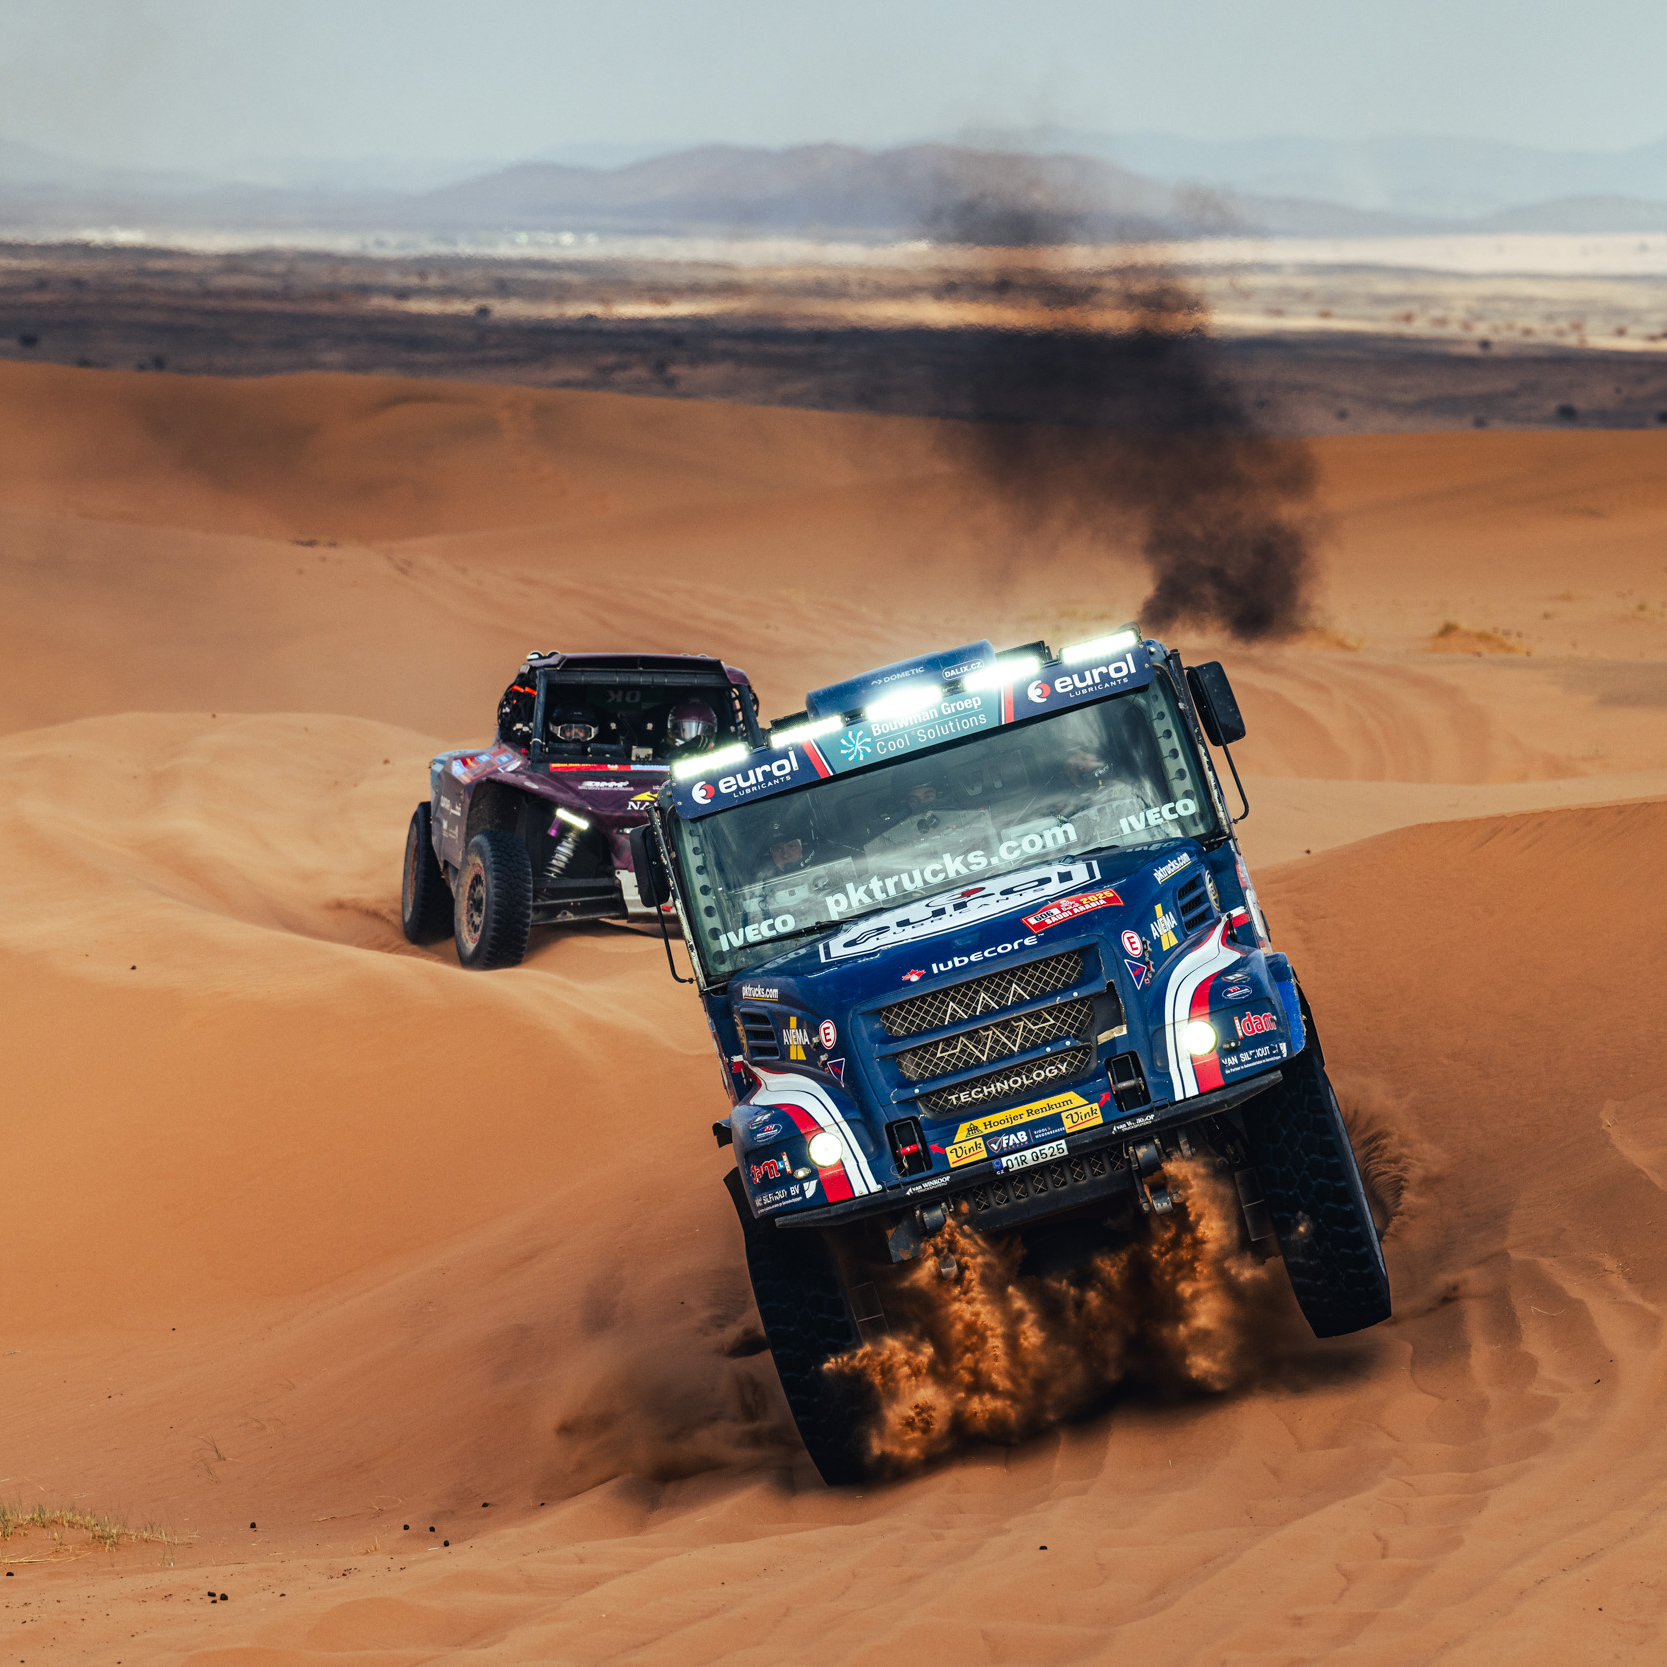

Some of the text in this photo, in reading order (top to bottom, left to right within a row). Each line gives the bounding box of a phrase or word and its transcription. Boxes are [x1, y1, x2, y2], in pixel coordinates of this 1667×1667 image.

[883, 667, 924, 684] DOMETIC
[944, 661, 982, 678] DALIX.CZ
[1054, 653, 1136, 693] eurol
[1069, 677, 1129, 698] LUBRICANTS
[871, 696, 981, 737] Bouwman Groep
[876, 714, 987, 755] Cool Solutions
[718, 750, 799, 794] eurol
[733, 775, 791, 798] LUBRICANTS
[1119, 799, 1196, 835] IVECO
[825, 821, 1078, 921] pktrucks.com
[1153, 852, 1191, 885] pktrucks.com
[1034, 910, 1054, 922] 606
[1045, 900, 1107, 925] SAUDI ARABIA
[718, 914, 796, 952] IVECO
[1150, 911, 1178, 940] AVEMA
[931, 935, 1038, 974] lubecore
[1129, 936, 1140, 952] E
[742, 984, 779, 1000] pktrucks.com
[783, 1028, 810, 1046] AVEMA
[823, 1026, 832, 1043] E
[948, 1062, 1069, 1106] TECHNOLOGY
[983, 1099, 1074, 1130] Hooijer Renkum
[1065, 1106, 1099, 1125] Vink
[949, 1141, 982, 1159] Vink
[1002, 1131, 1028, 1149] FAB
[1006, 1154, 1028, 1170] 01R
[1031, 1143, 1065, 1162] 0525
[789, 1184, 800, 1196] BV
